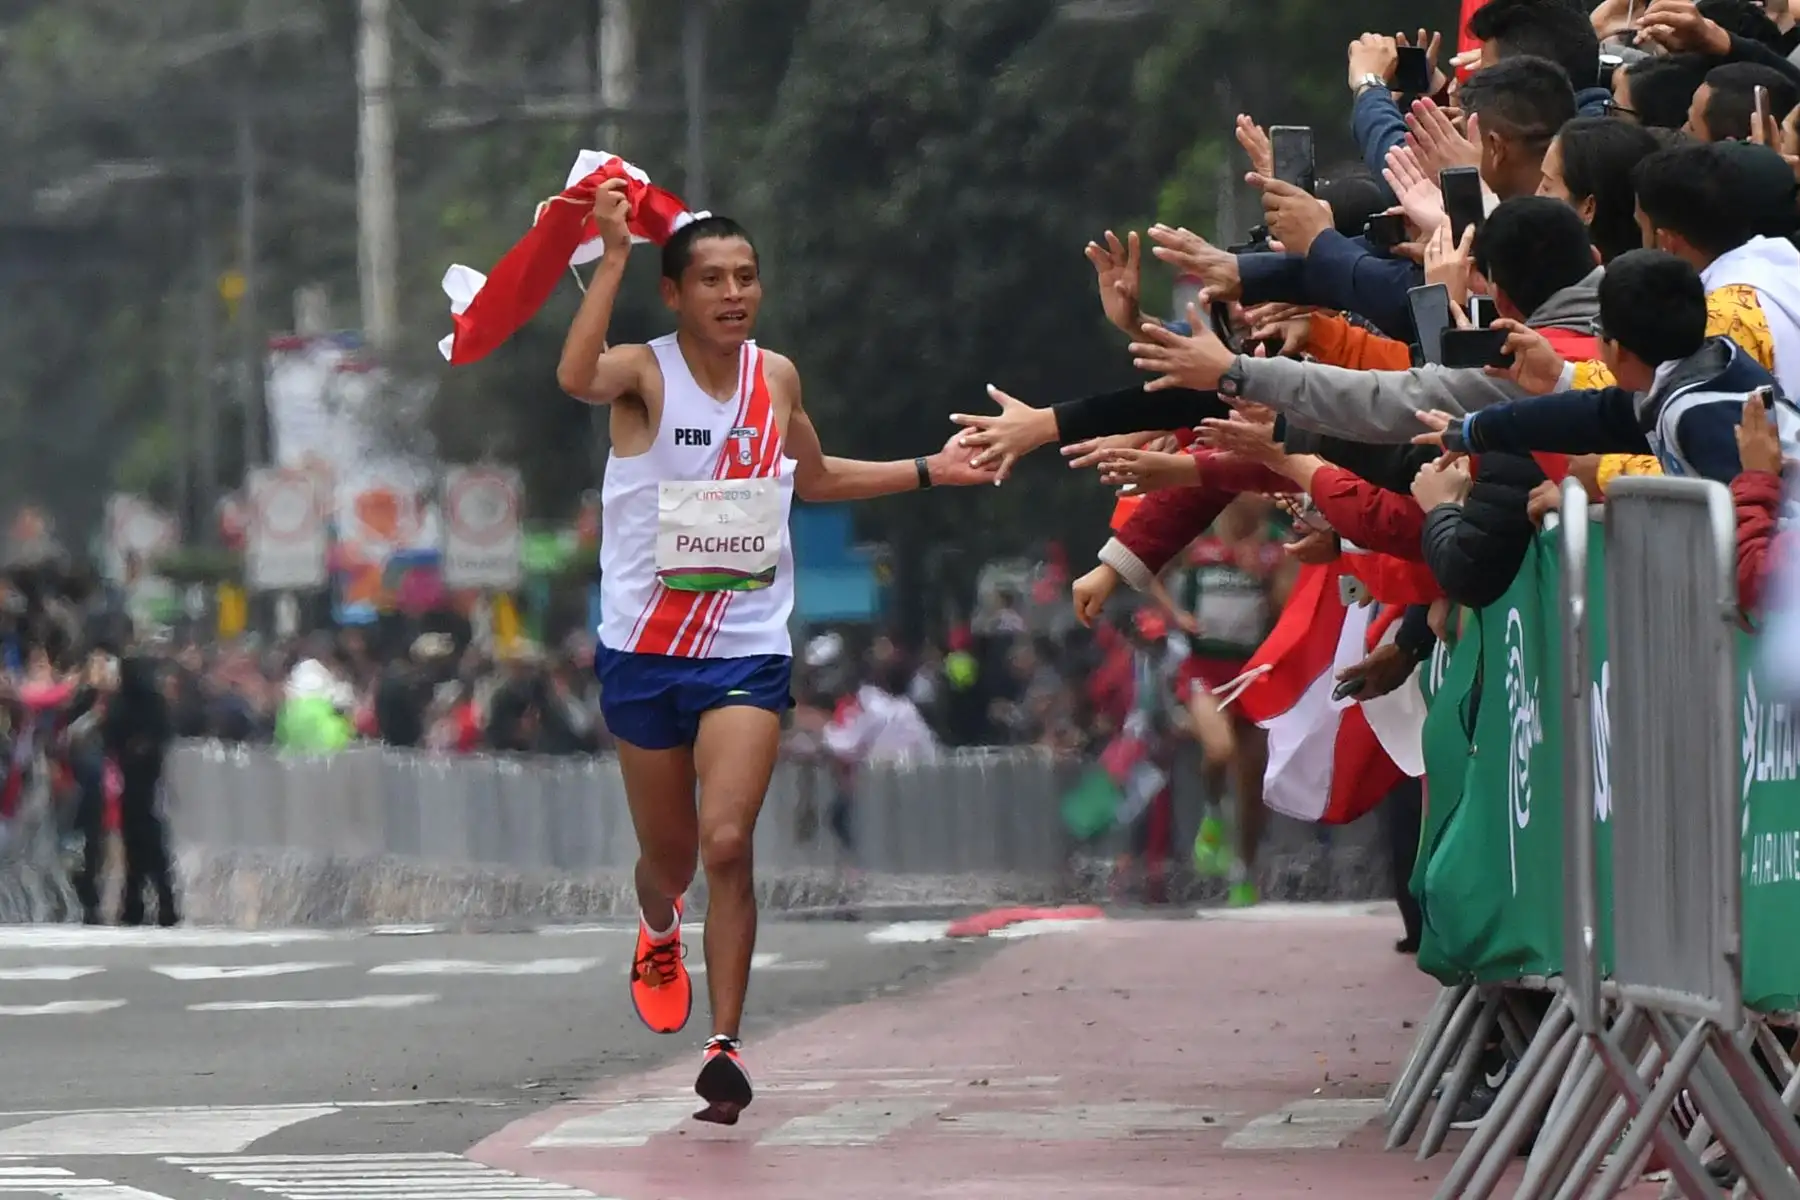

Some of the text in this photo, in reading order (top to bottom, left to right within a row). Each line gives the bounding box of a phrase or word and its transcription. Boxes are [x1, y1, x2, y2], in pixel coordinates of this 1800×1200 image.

[675, 428, 711, 446] PERU
[676, 535, 765, 553] PACHECO
[1756, 703, 1800, 781] LATA
